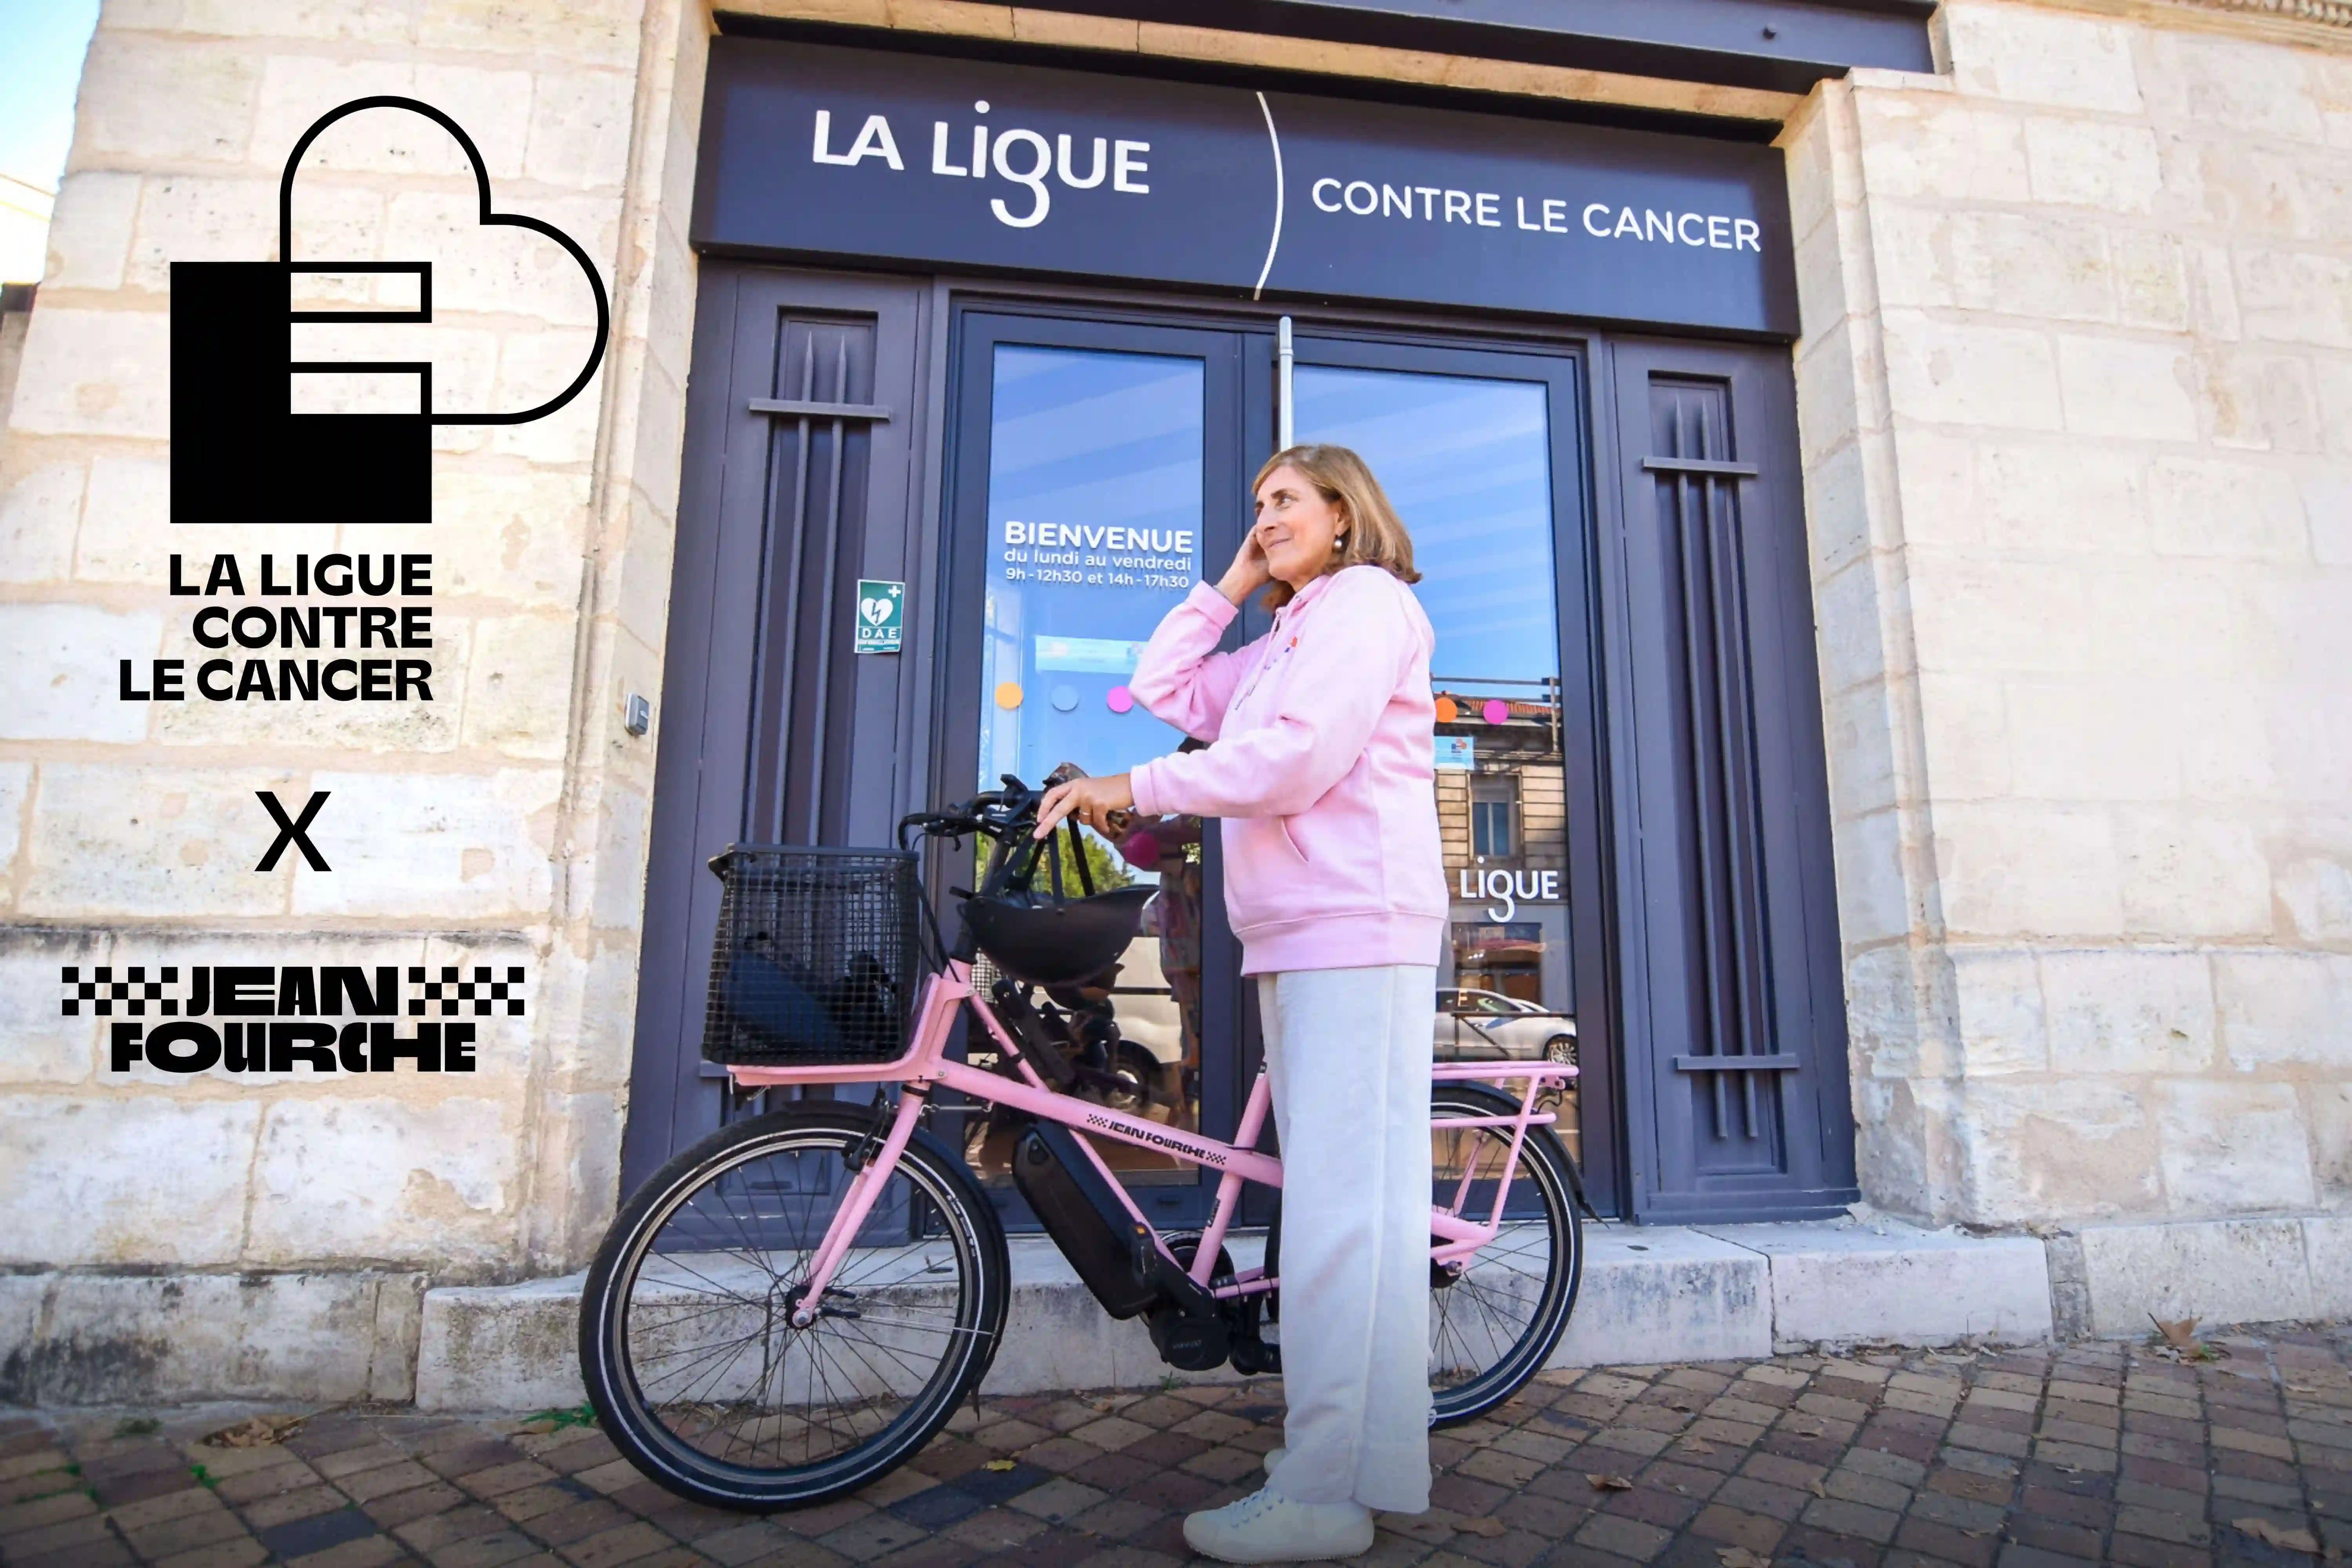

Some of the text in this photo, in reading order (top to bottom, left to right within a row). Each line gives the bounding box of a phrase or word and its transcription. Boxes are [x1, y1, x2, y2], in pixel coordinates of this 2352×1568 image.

[813, 110, 904, 170] LA
[1312, 178, 1761, 252] CONTRE LE CANCER
[1005, 521, 1193, 553] BIENVENUE
[1004, 548, 1191, 571] du lundi au vendredi
[1087, 572, 1103, 584] et
[862, 627, 897, 639] DAE
